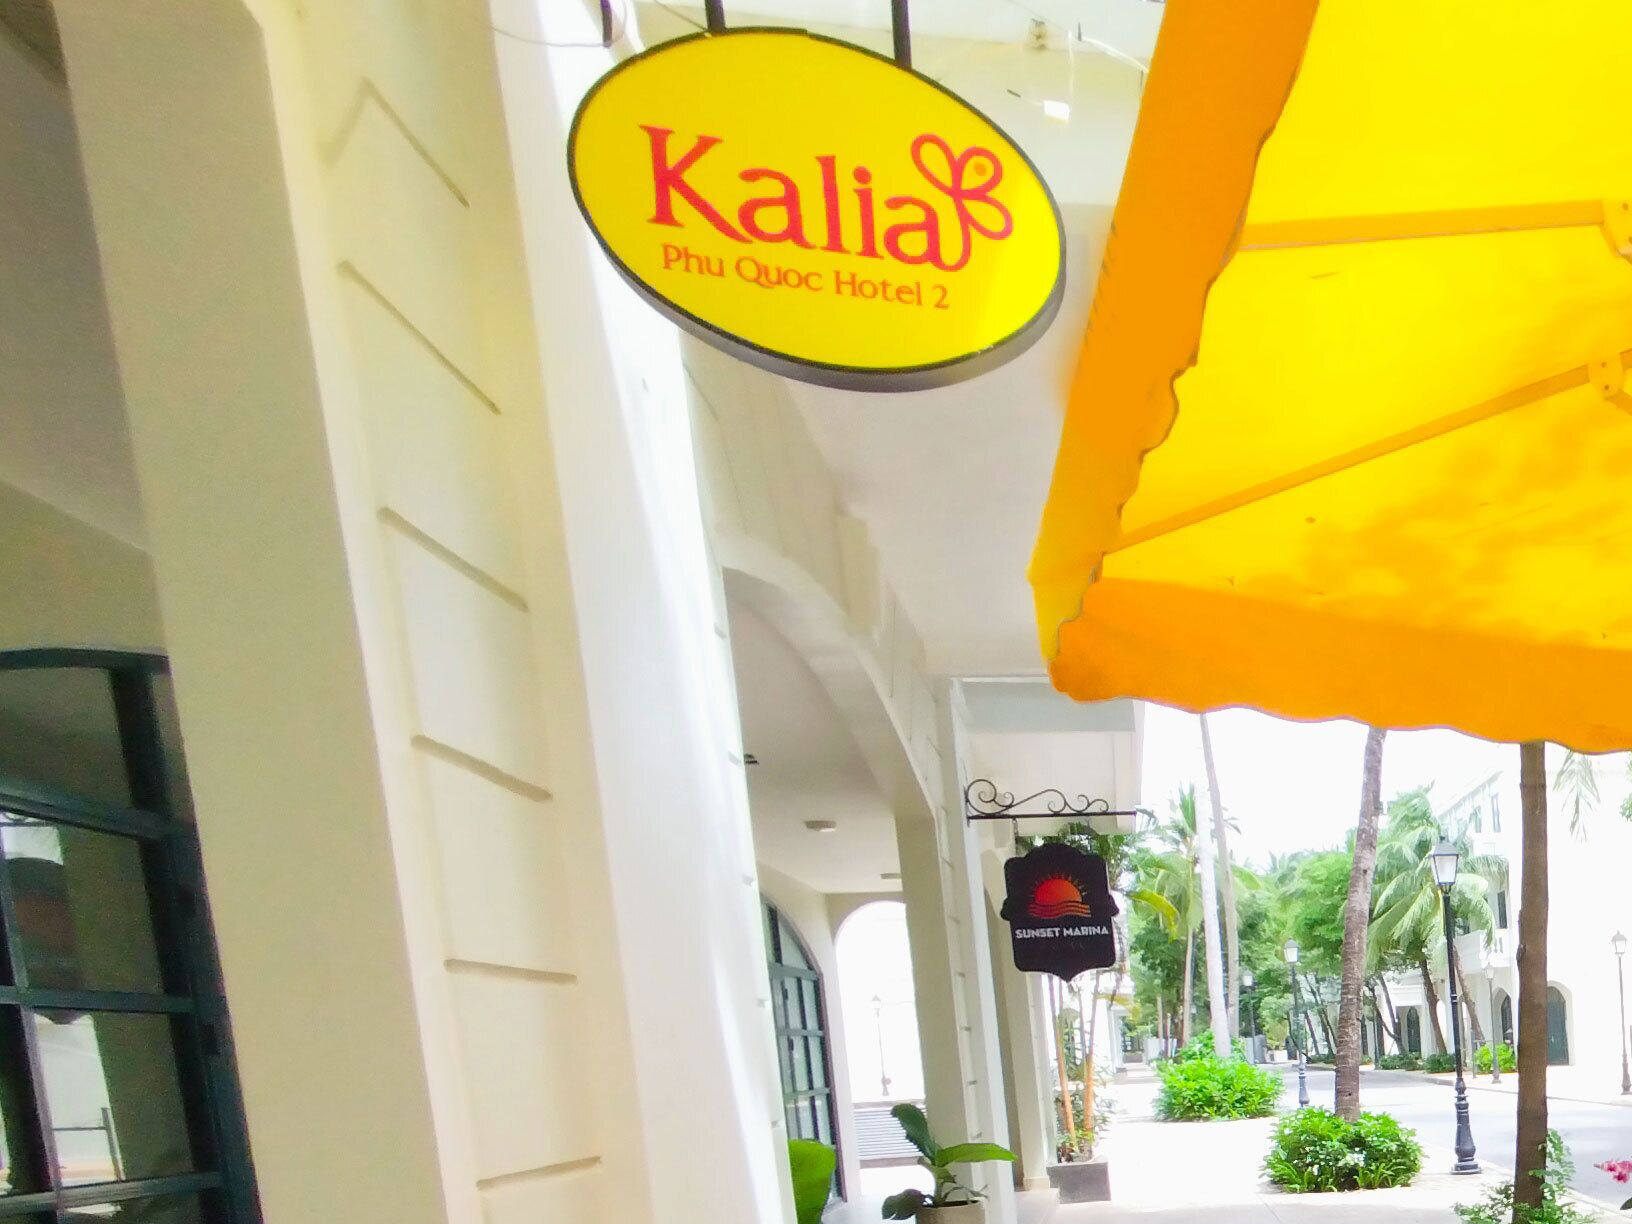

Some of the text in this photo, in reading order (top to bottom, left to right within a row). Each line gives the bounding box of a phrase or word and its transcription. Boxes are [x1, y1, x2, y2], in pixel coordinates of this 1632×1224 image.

[639, 124, 950, 270] Kalia
[662, 243, 950, 310] Phu Quoc Hotel 2
[1016, 926, 1109, 939] SUNSET MARINA
